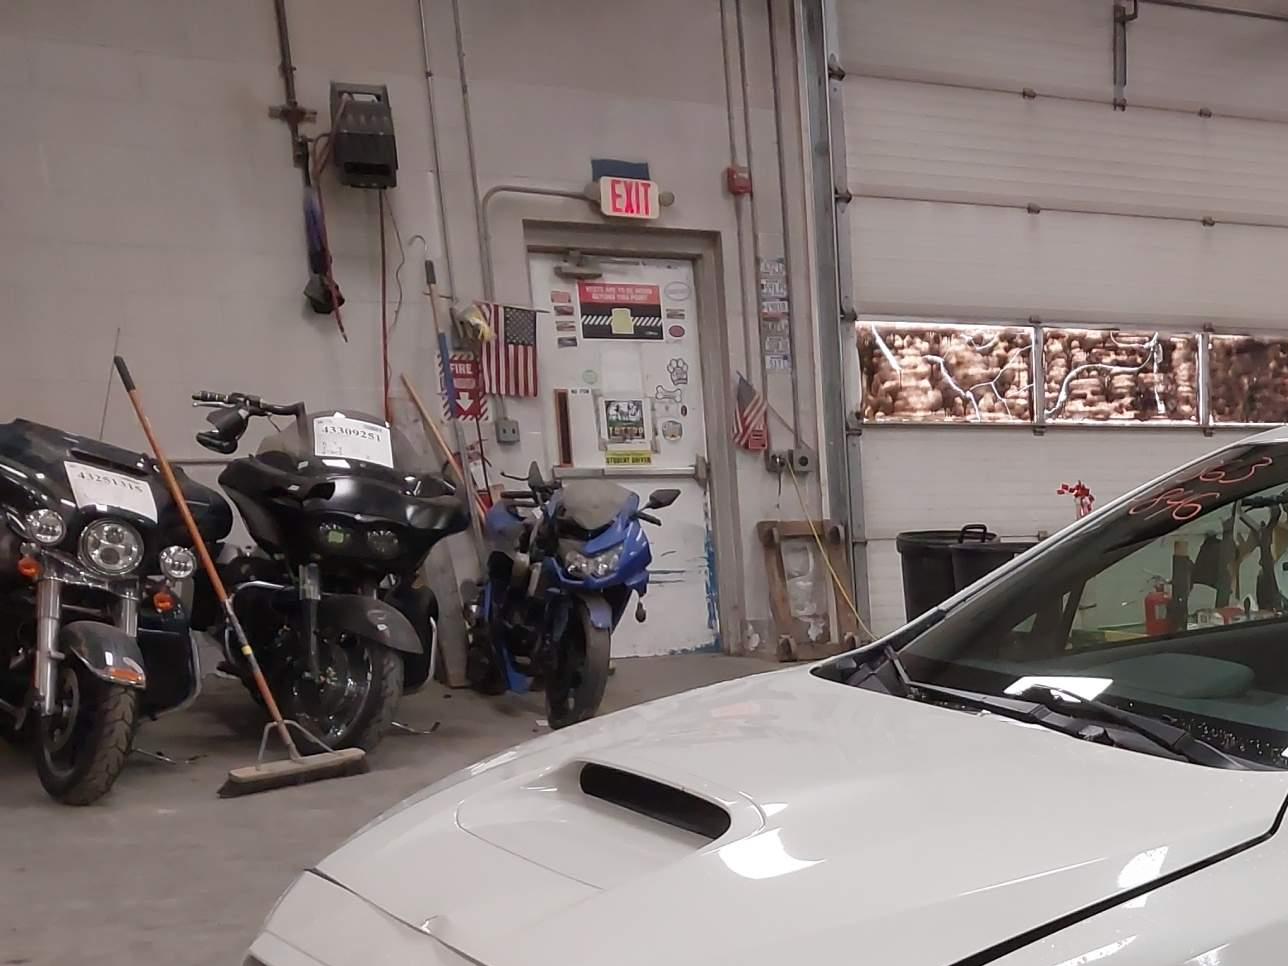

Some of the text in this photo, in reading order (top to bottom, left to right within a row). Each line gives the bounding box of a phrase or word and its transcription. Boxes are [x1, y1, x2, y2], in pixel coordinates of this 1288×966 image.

[611, 179, 651, 216] EXIT
[450, 363, 473, 375] FIRE
[321, 425, 381, 443] 43309251
[606, 456, 630, 465] STUDENT
